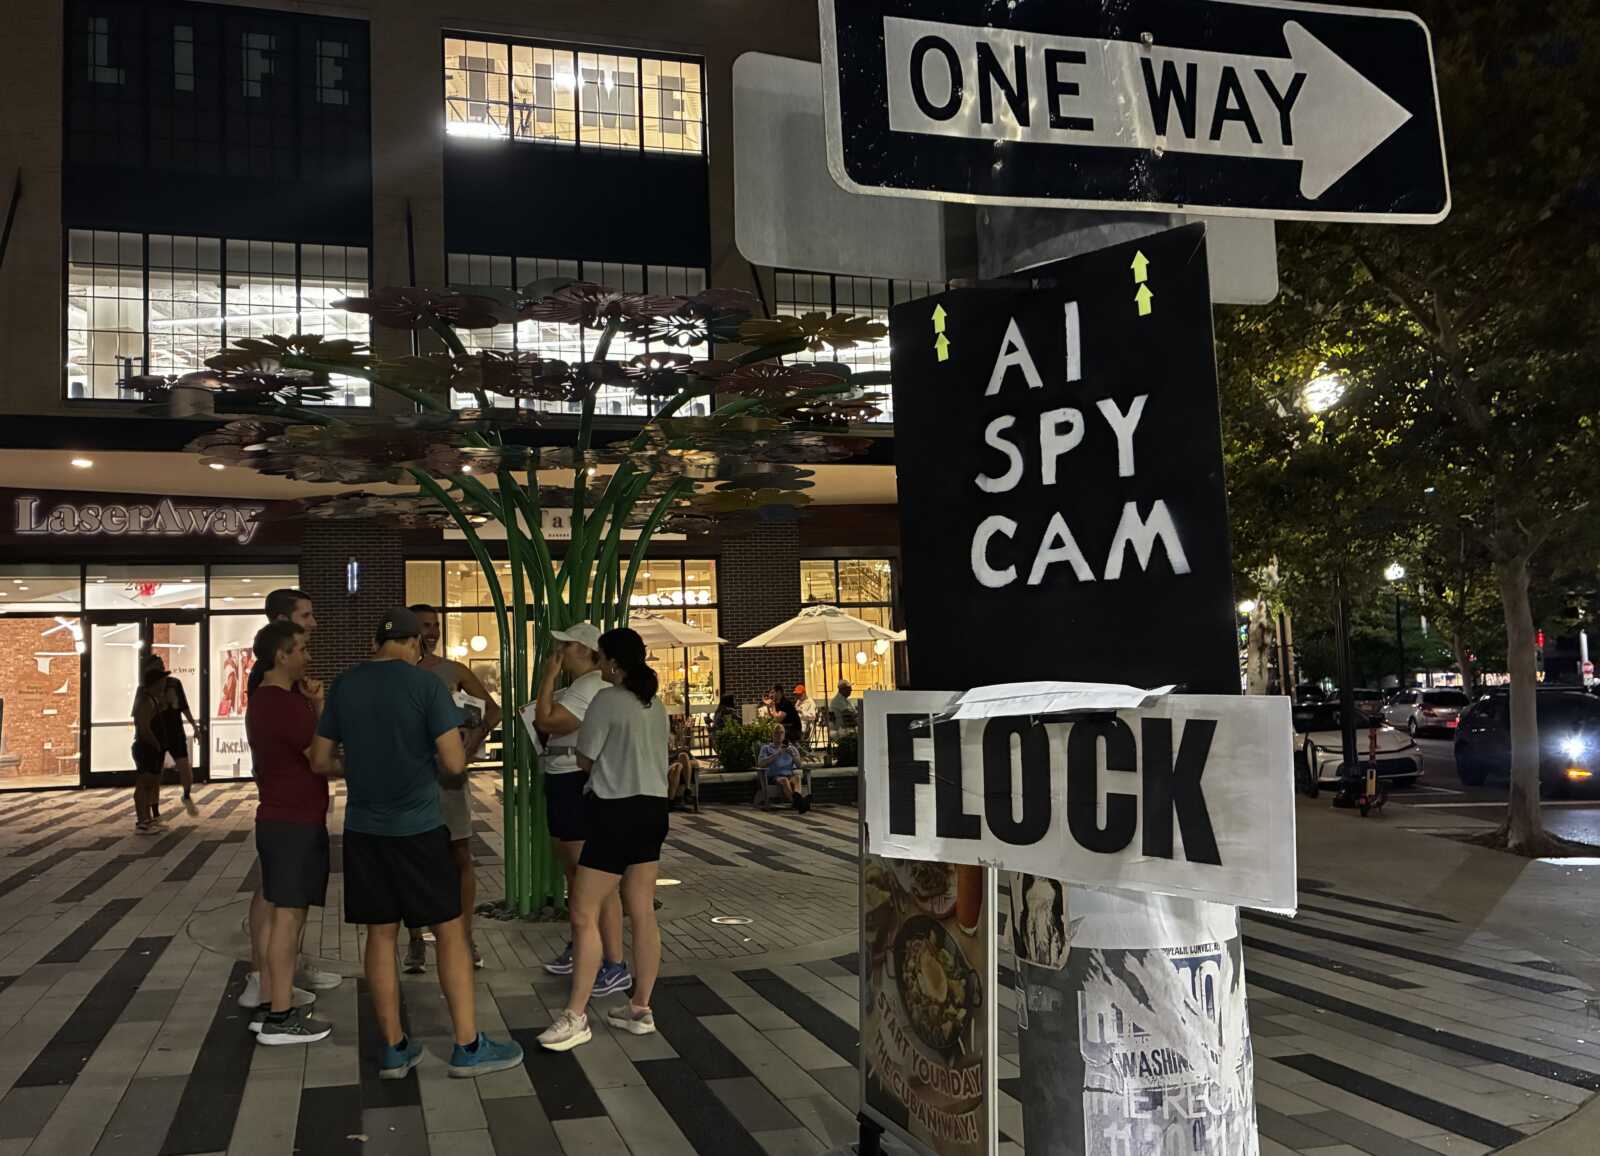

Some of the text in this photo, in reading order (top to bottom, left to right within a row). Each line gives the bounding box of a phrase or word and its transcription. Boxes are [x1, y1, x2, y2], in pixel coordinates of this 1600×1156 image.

[88, 16, 349, 105] LIFE
[909, 35, 1308, 146] ONE WAY
[984, 300, 1082, 397] AI
[973, 394, 1149, 494] SPY
[15, 496, 265, 545] LaserAway
[971, 499, 1192, 588] CAM
[886, 711, 1223, 867] FLOCK
[876, 991, 983, 1100] START YOUR DAY
[1119, 1047, 1195, 1079] WASHIN
